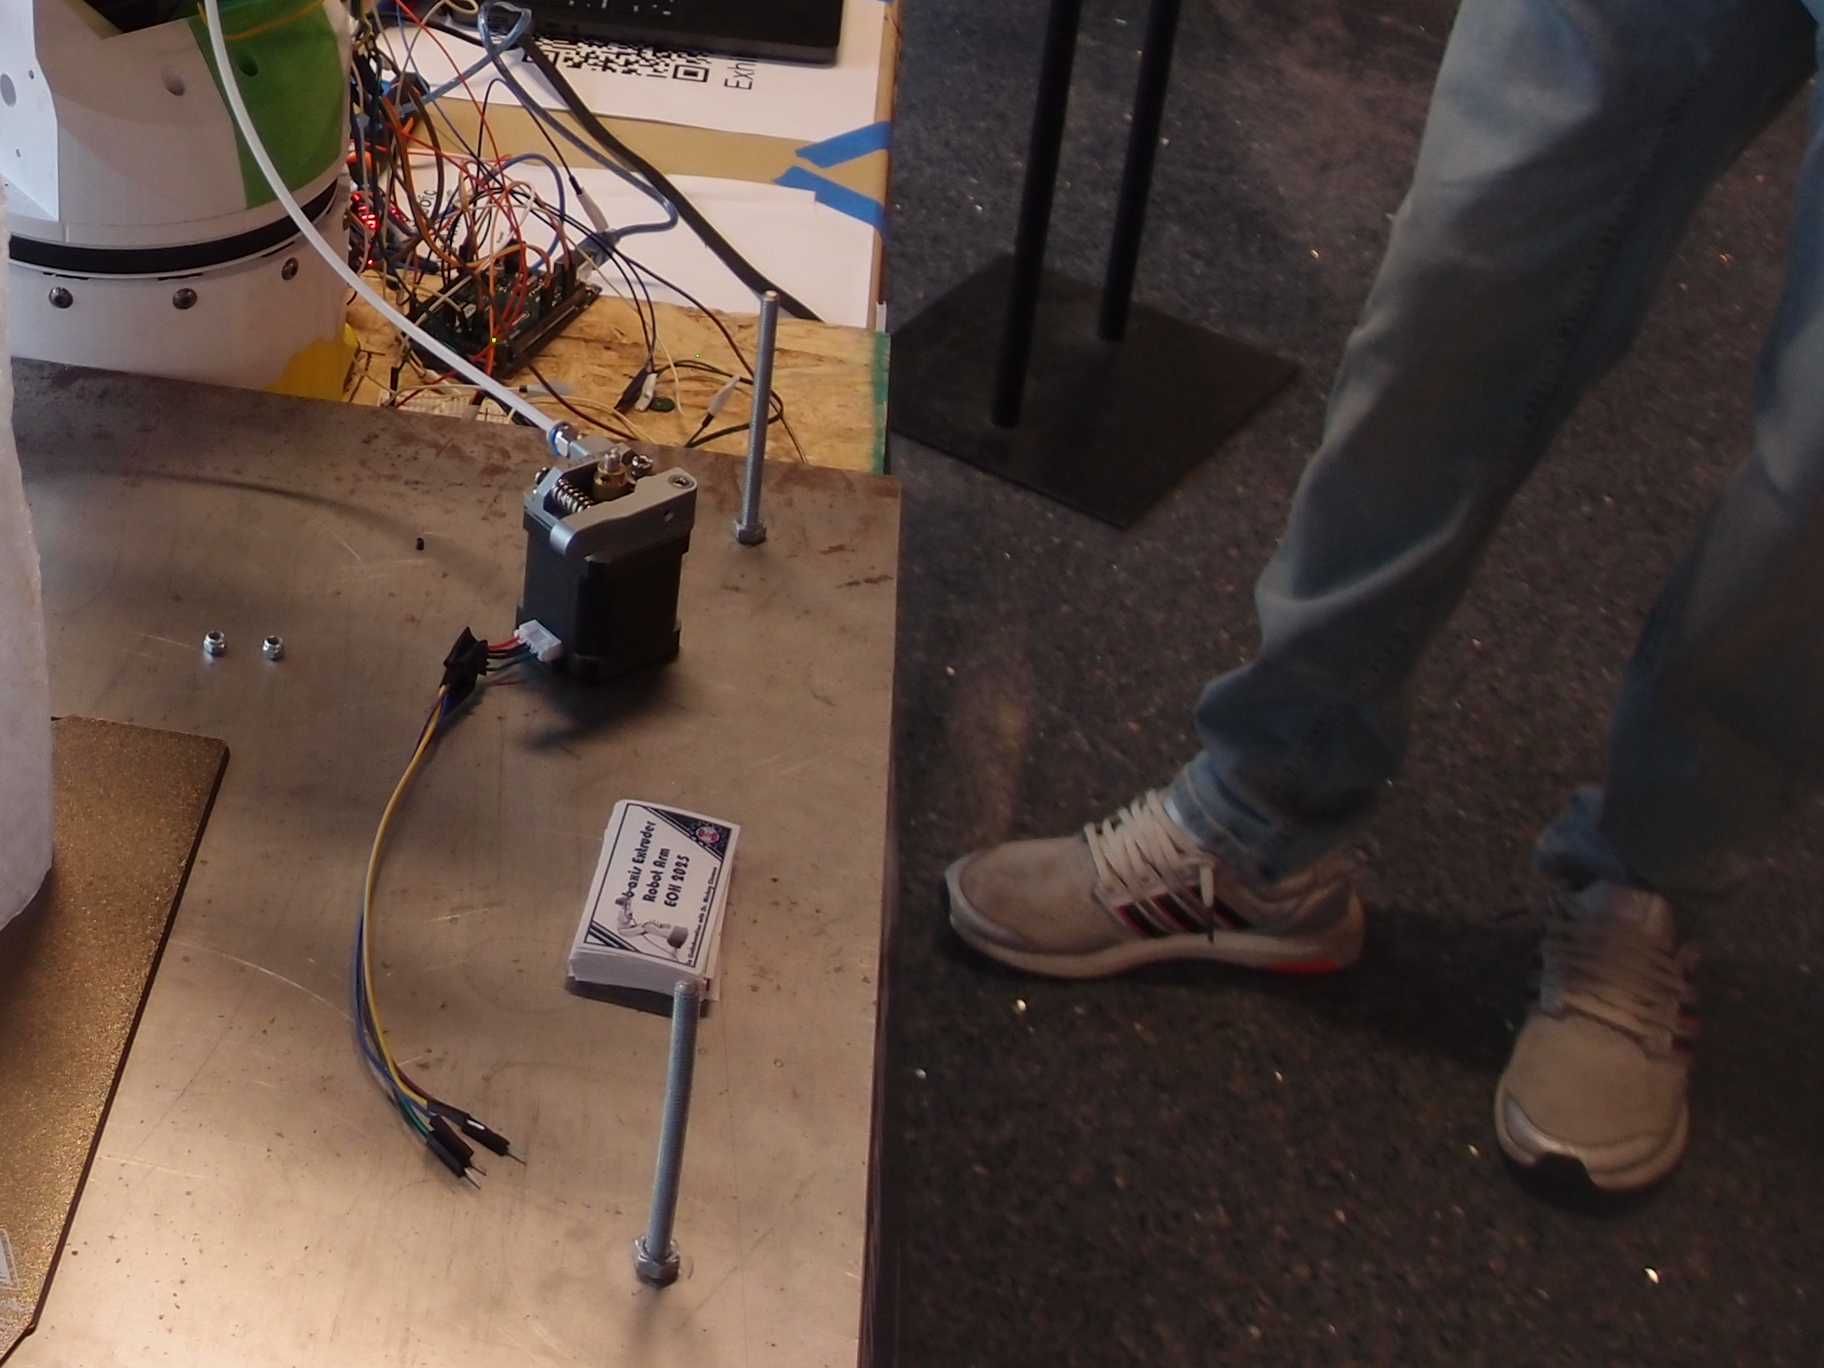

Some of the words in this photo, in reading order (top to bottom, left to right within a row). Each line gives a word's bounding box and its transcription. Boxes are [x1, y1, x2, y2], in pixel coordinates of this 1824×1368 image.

[632, 820, 656, 864] Extruder
[642, 870, 664, 902] Robot
[653, 847, 670, 869] Arm
[671, 854, 690, 882] 2025
[664, 883, 683, 908] EOH
